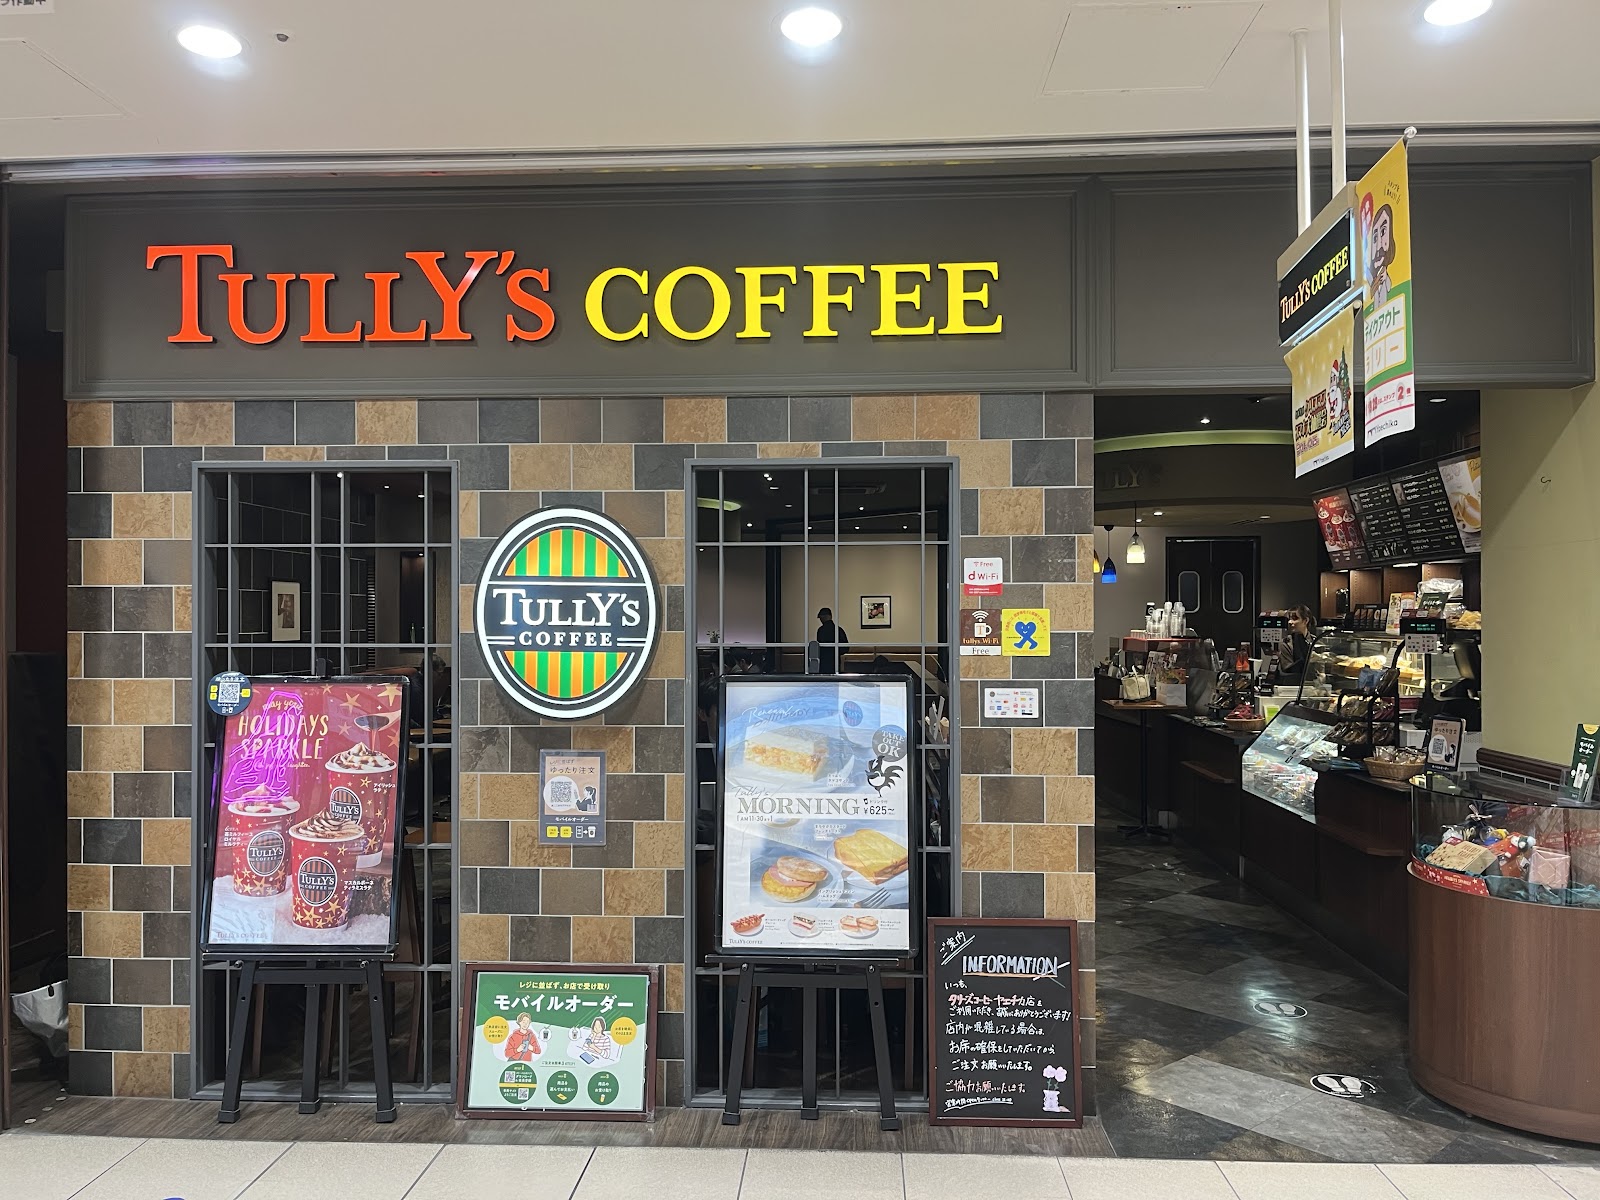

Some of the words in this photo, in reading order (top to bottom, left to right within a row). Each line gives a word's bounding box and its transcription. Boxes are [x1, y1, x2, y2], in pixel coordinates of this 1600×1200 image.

[1280, 278, 1311, 320] TULLY'S
[1311, 246, 1348, 295] COFFEE
[146, 245, 556, 344] TULLY'S
[584, 261, 1004, 342] COFFEE
[968, 571, 976, 581] d
[492, 588, 641, 627] TULLY'S
[518, 631, 613, 647] COFFEE
[972, 647, 990, 655] Free
[238, 714, 329, 737] HOLIDAYS
[881, 730, 907, 742] TAKE
[882, 736, 901, 747] OUT
[240, 738, 325, 759] SPARKLE
[877, 743, 901, 758] OK
[550, 766, 595, 775] ゆったり注文
[737, 797, 860, 815] MORNING
[249, 847, 283, 857] TULLY'S
[300, 873, 335, 886] TULLY'S
[939, 930, 967, 958] ご案内
[962, 955, 1058, 975] INFORMATION
[519, 981, 610, 991] レジに並ばず、お店で受け取り
[493, 994, 634, 1014] モバイルオーダー
